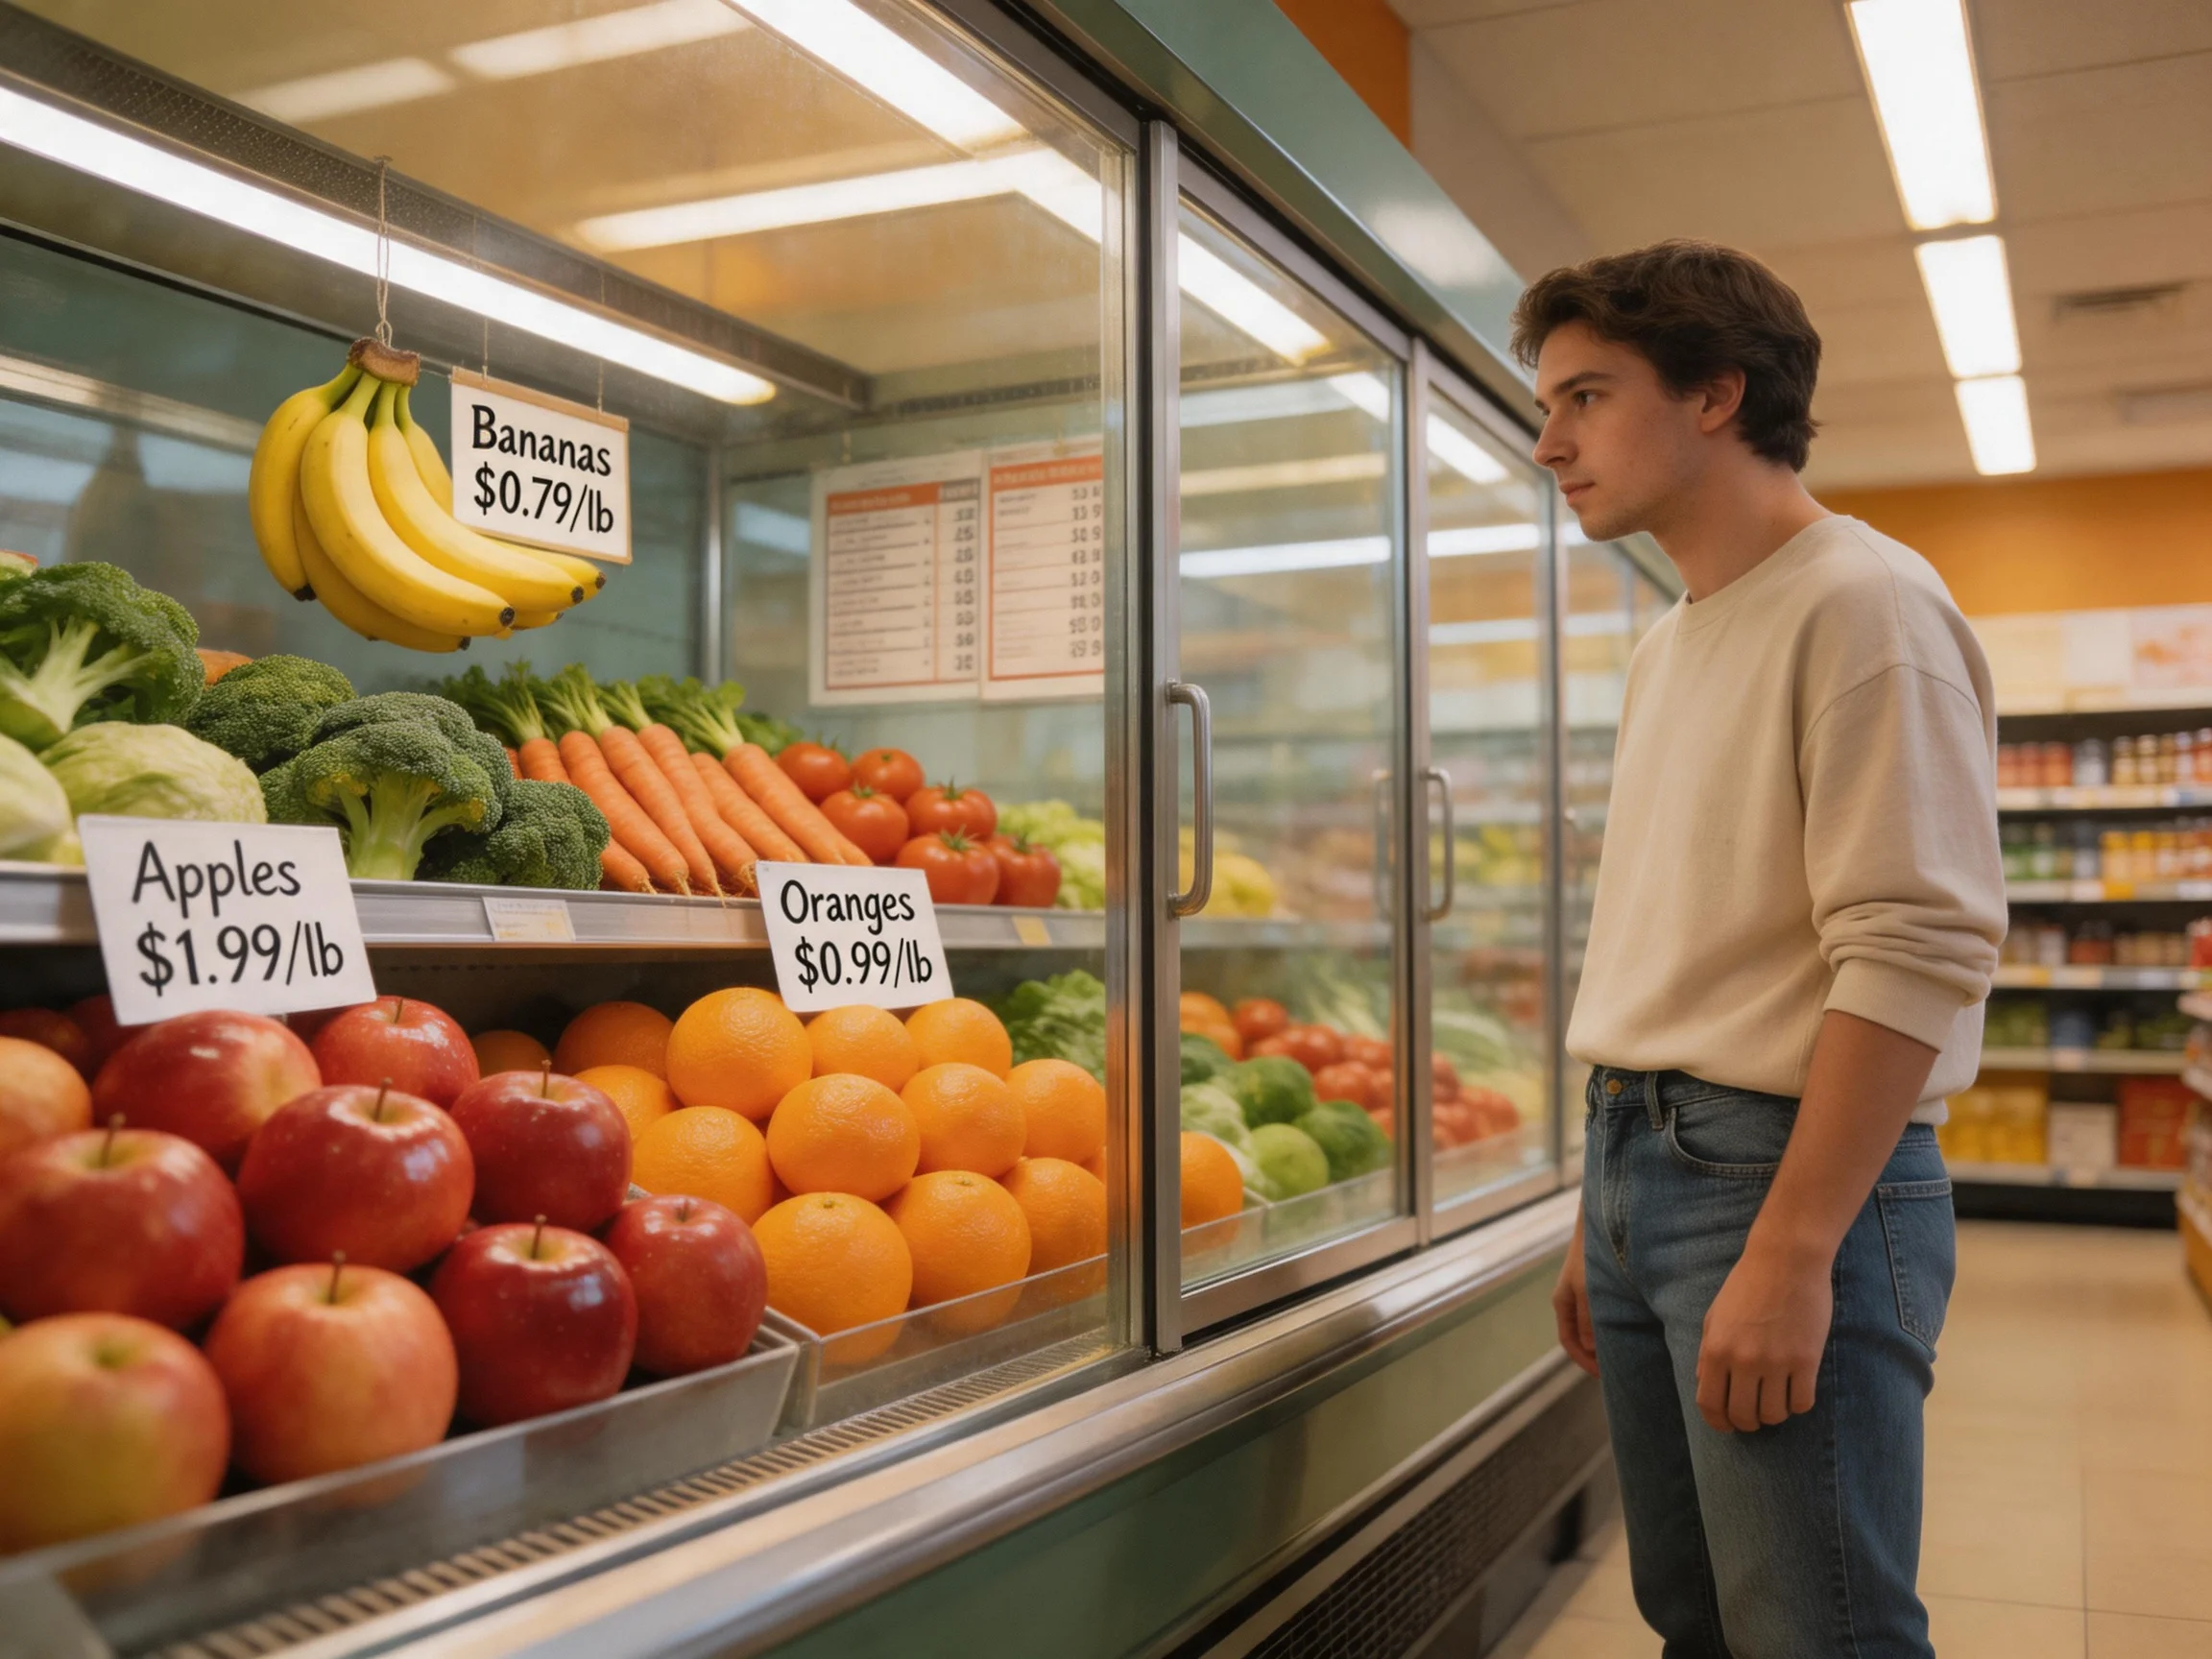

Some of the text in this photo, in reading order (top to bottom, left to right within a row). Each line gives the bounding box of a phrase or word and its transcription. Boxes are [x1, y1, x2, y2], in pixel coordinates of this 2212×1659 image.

[471, 404, 612, 476] Bananas
[474, 461, 613, 533] $0.79/lb
[132, 839, 301, 919] Apples
[781, 879, 915, 935] Oranges
[136, 921, 344, 997] $1.99/lb
[795, 936, 932, 994] $0.99/lb
